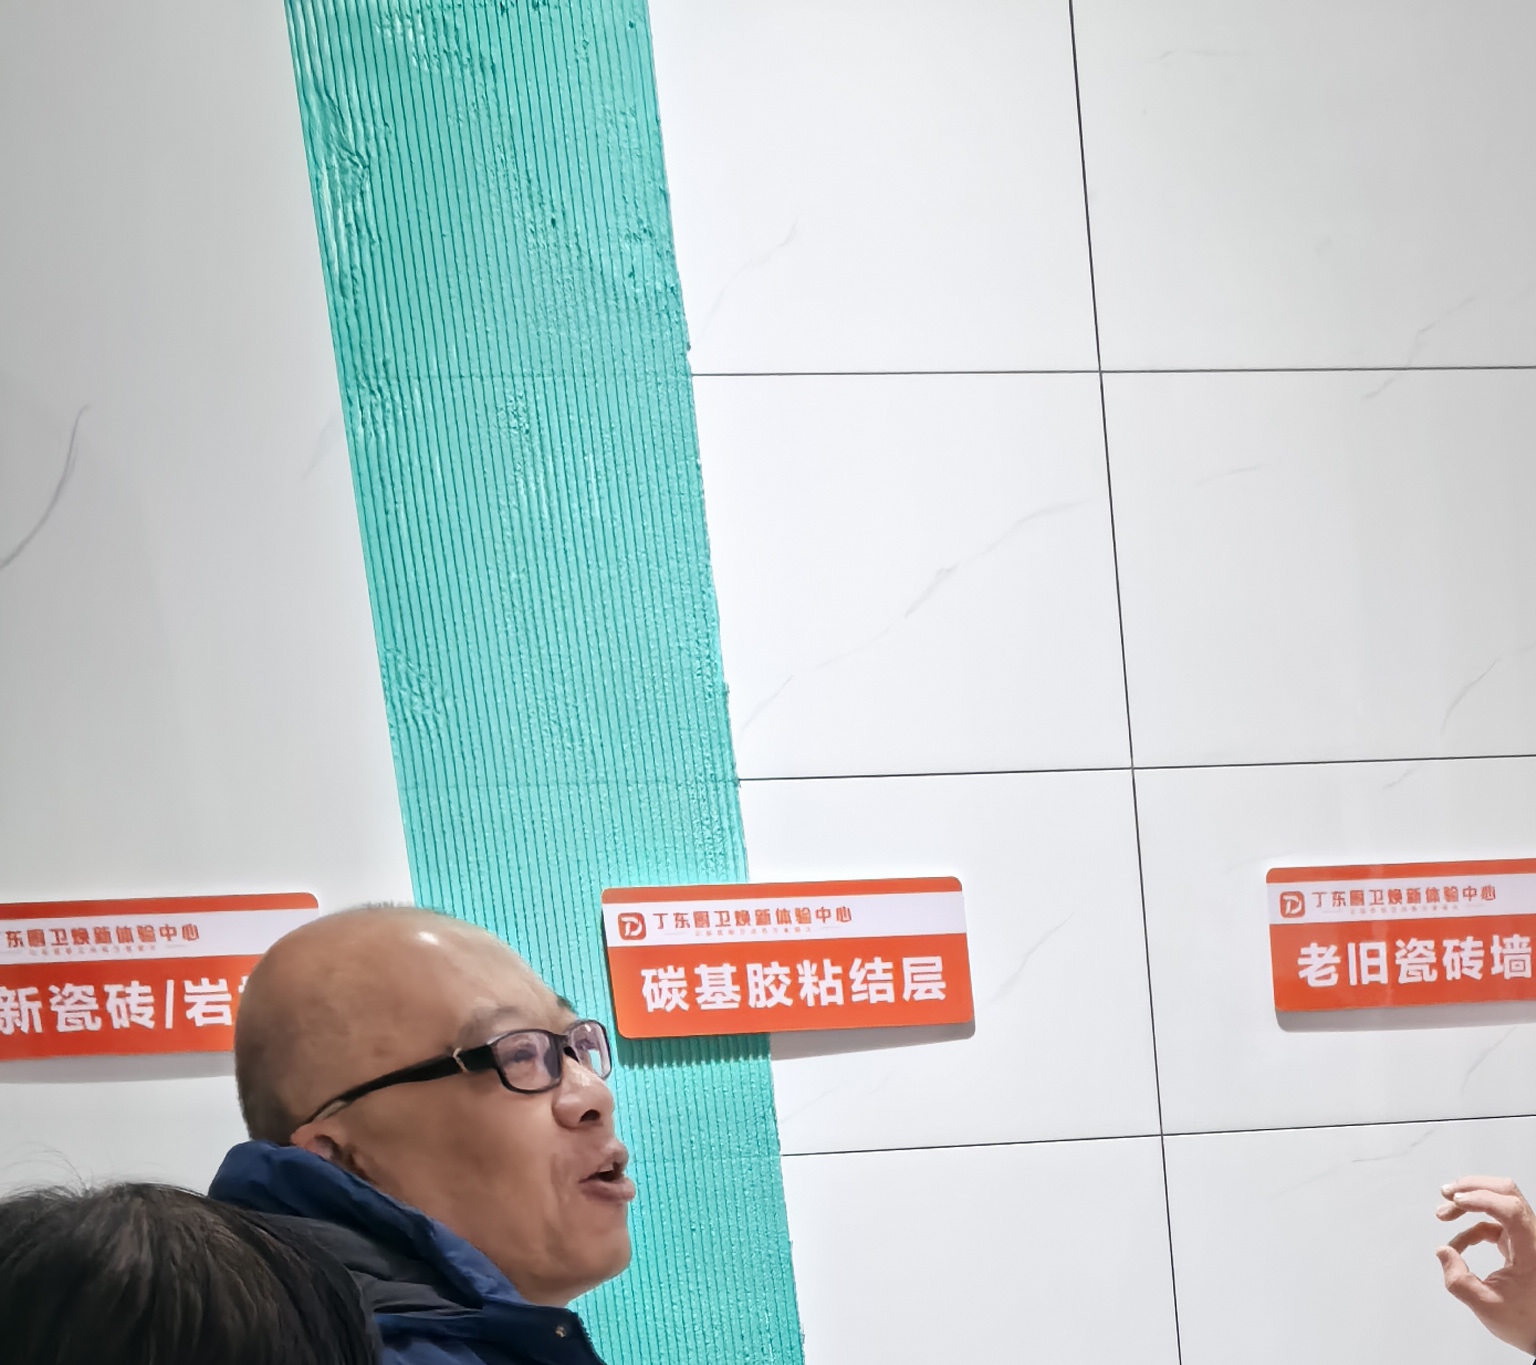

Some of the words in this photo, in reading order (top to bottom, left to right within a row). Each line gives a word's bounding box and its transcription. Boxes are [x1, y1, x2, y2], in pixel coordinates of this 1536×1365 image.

[0, 975, 249, 1036] 新瓷砖/岩
[640, 955, 947, 1013] 碳基胶粘结层
